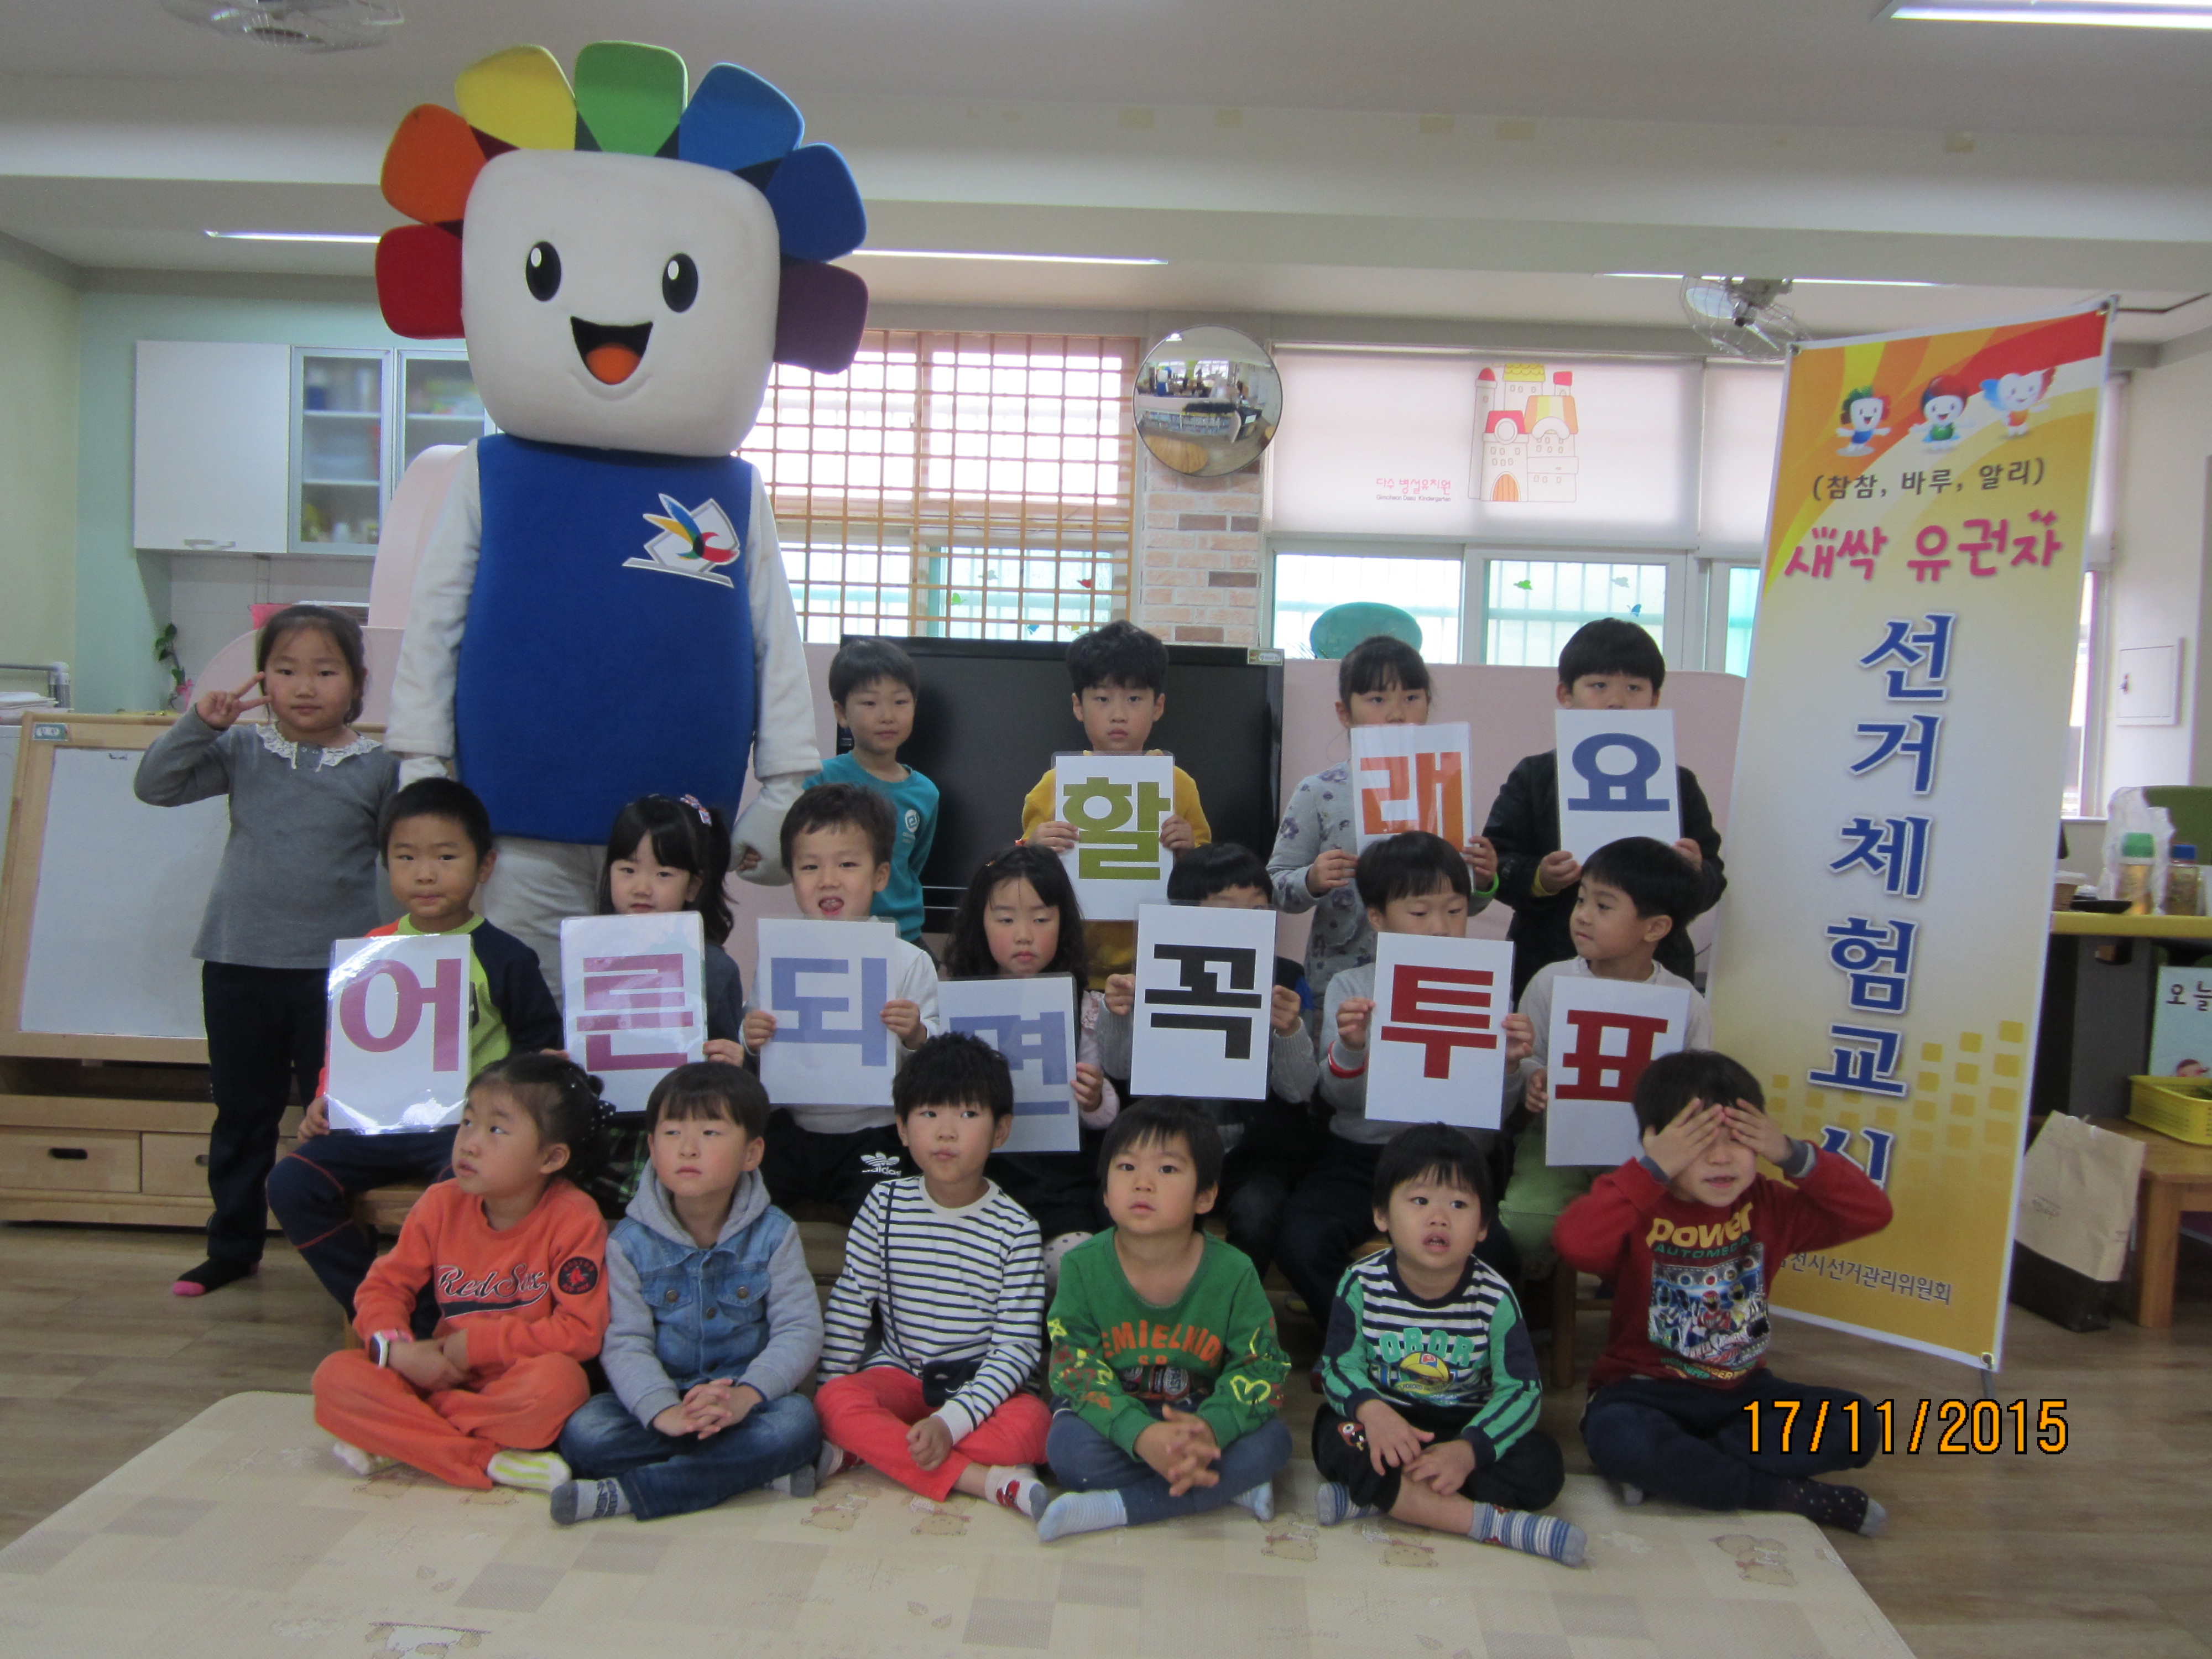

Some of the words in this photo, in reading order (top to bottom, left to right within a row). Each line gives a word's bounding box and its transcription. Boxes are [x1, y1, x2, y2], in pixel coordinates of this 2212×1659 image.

[1376, 478, 1395, 489] 다수
[1399, 478, 1452, 495] 병설유치원
[1901, 468, 1964, 495] 바루,
[1979, 457, 2045, 491] 알리)
[1784, 526, 1888, 581] 새싹
[1907, 515, 2063, 581] 유권자
[1062, 777, 1171, 880] 할
[1360, 752, 1464, 852] 래
[1568, 732, 1671, 812] 요
[340, 958, 462, 1072] 어
[576, 953, 693, 1072] 른
[770, 957, 888, 1067] 되
[1144, 943, 1262, 1060] 꼭
[1380, 964, 1498, 1080] 투
[1555, 1009, 1668, 1103] 표
[1780, 1251, 1952, 1306] 천시선거관리위원회
